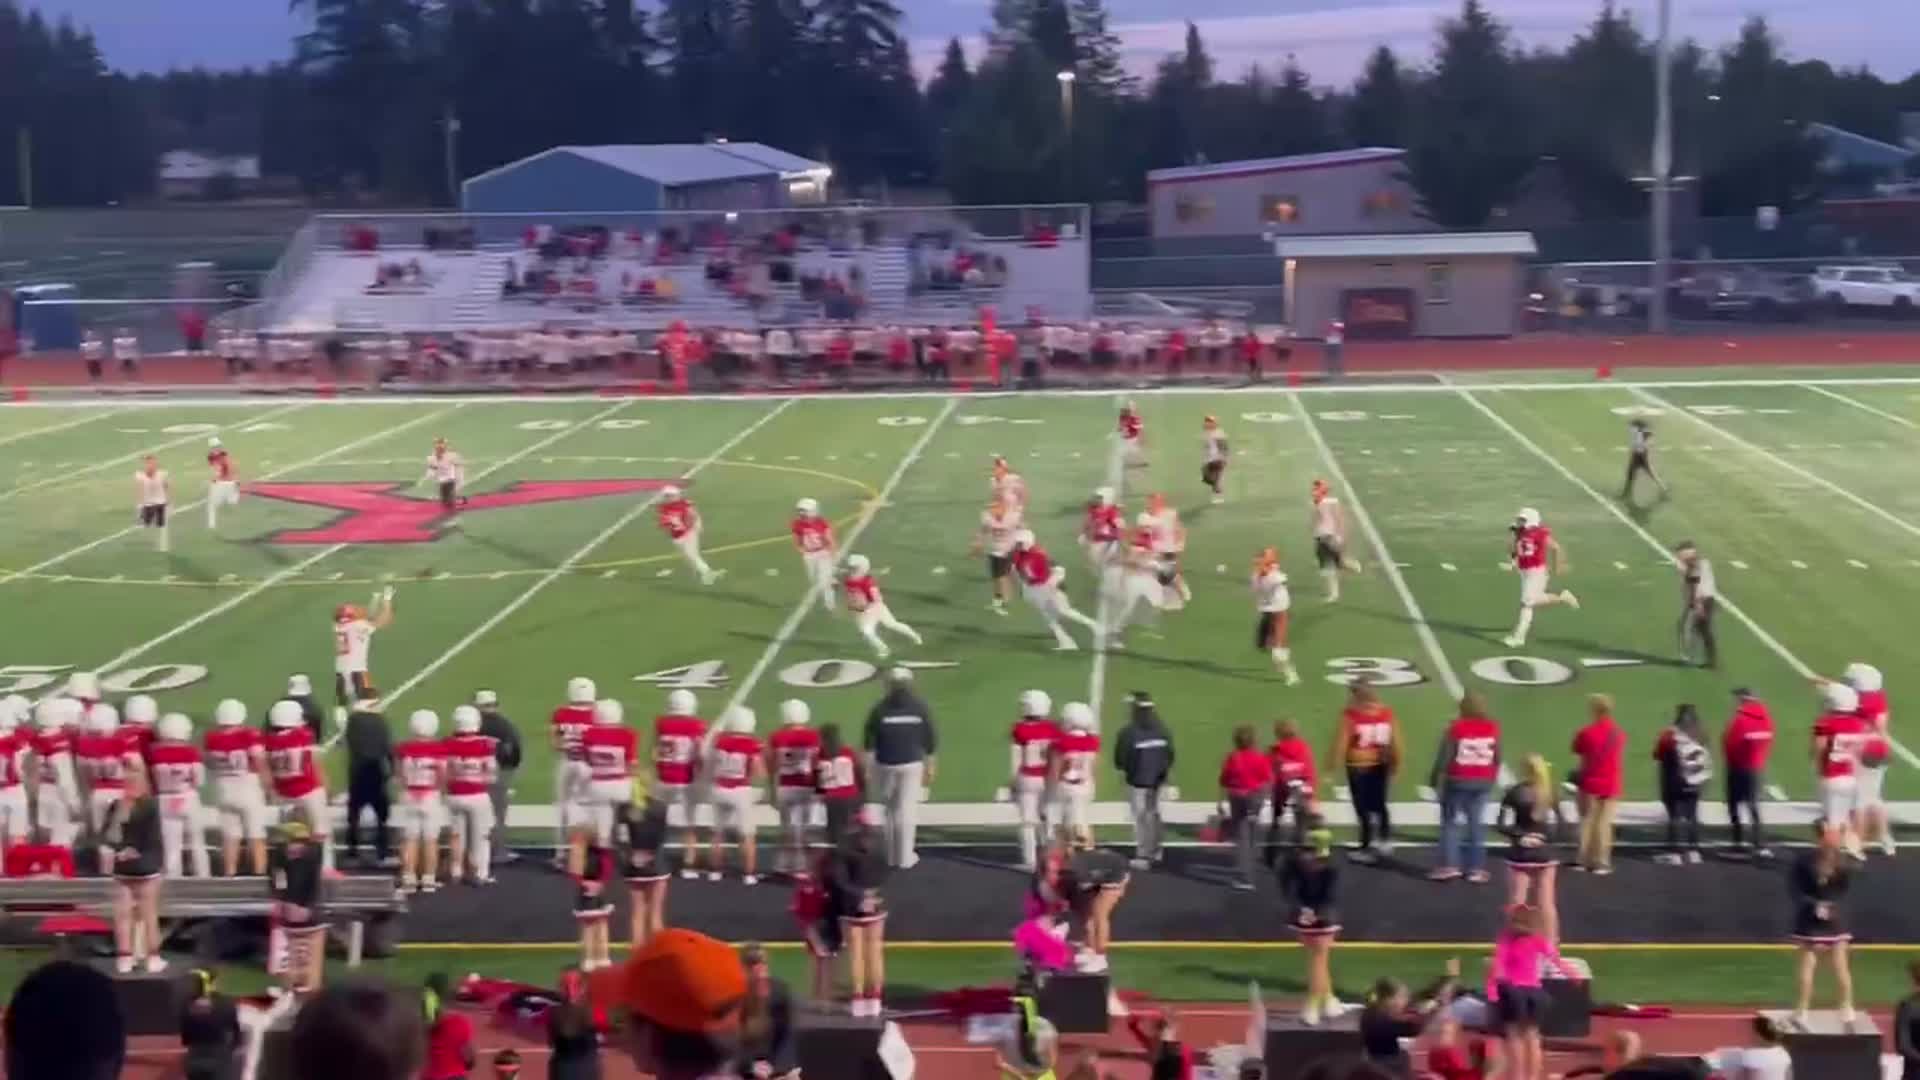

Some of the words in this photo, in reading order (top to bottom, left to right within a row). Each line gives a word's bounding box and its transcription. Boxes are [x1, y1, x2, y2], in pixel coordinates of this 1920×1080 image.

[0, 663, 208, 692] 50
[632, 659, 877, 688] 40
[1324, 656, 1573, 686] 30
